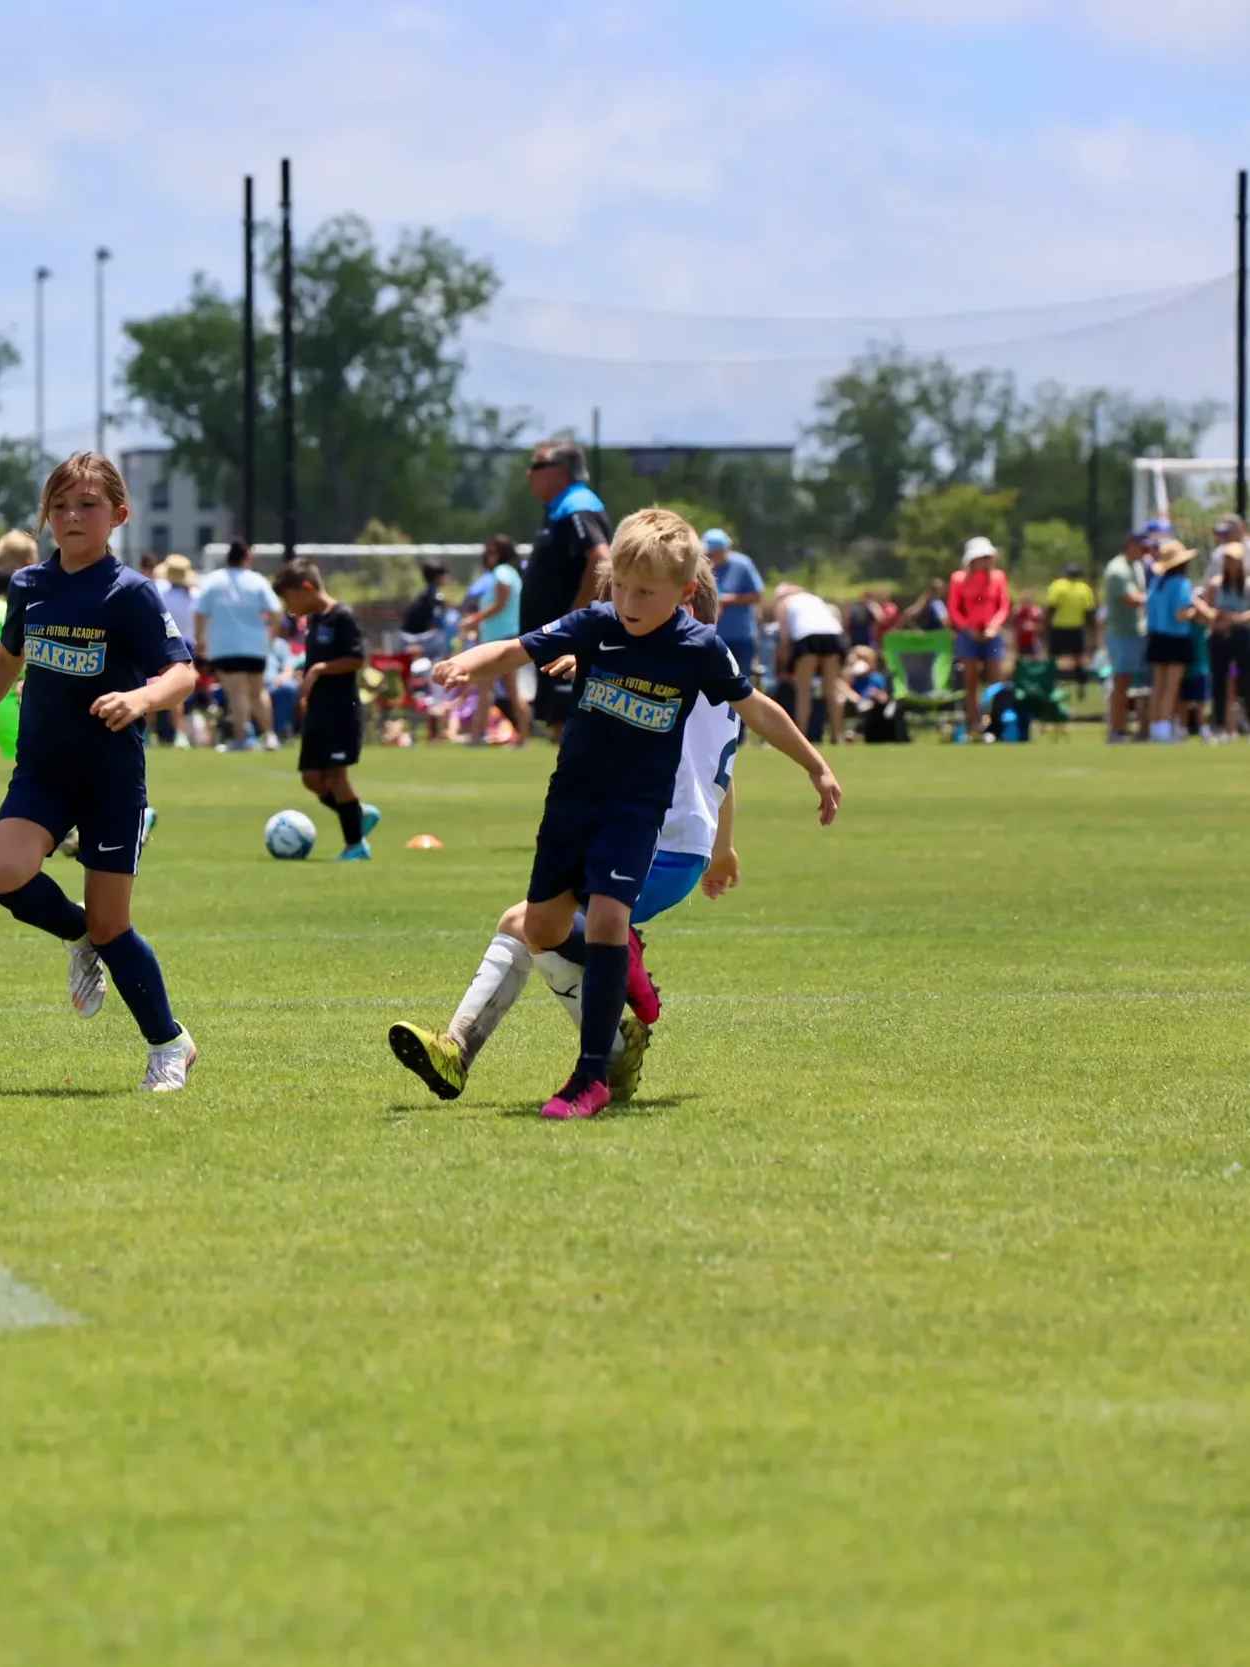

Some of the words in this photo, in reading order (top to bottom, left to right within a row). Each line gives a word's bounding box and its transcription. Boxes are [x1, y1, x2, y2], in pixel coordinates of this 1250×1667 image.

[46, 625, 70, 637] FUTBOL
[71, 627, 106, 639] ACADEMY
[24, 639, 100, 673] REAKERS
[625, 677, 652, 693] FUTBOL
